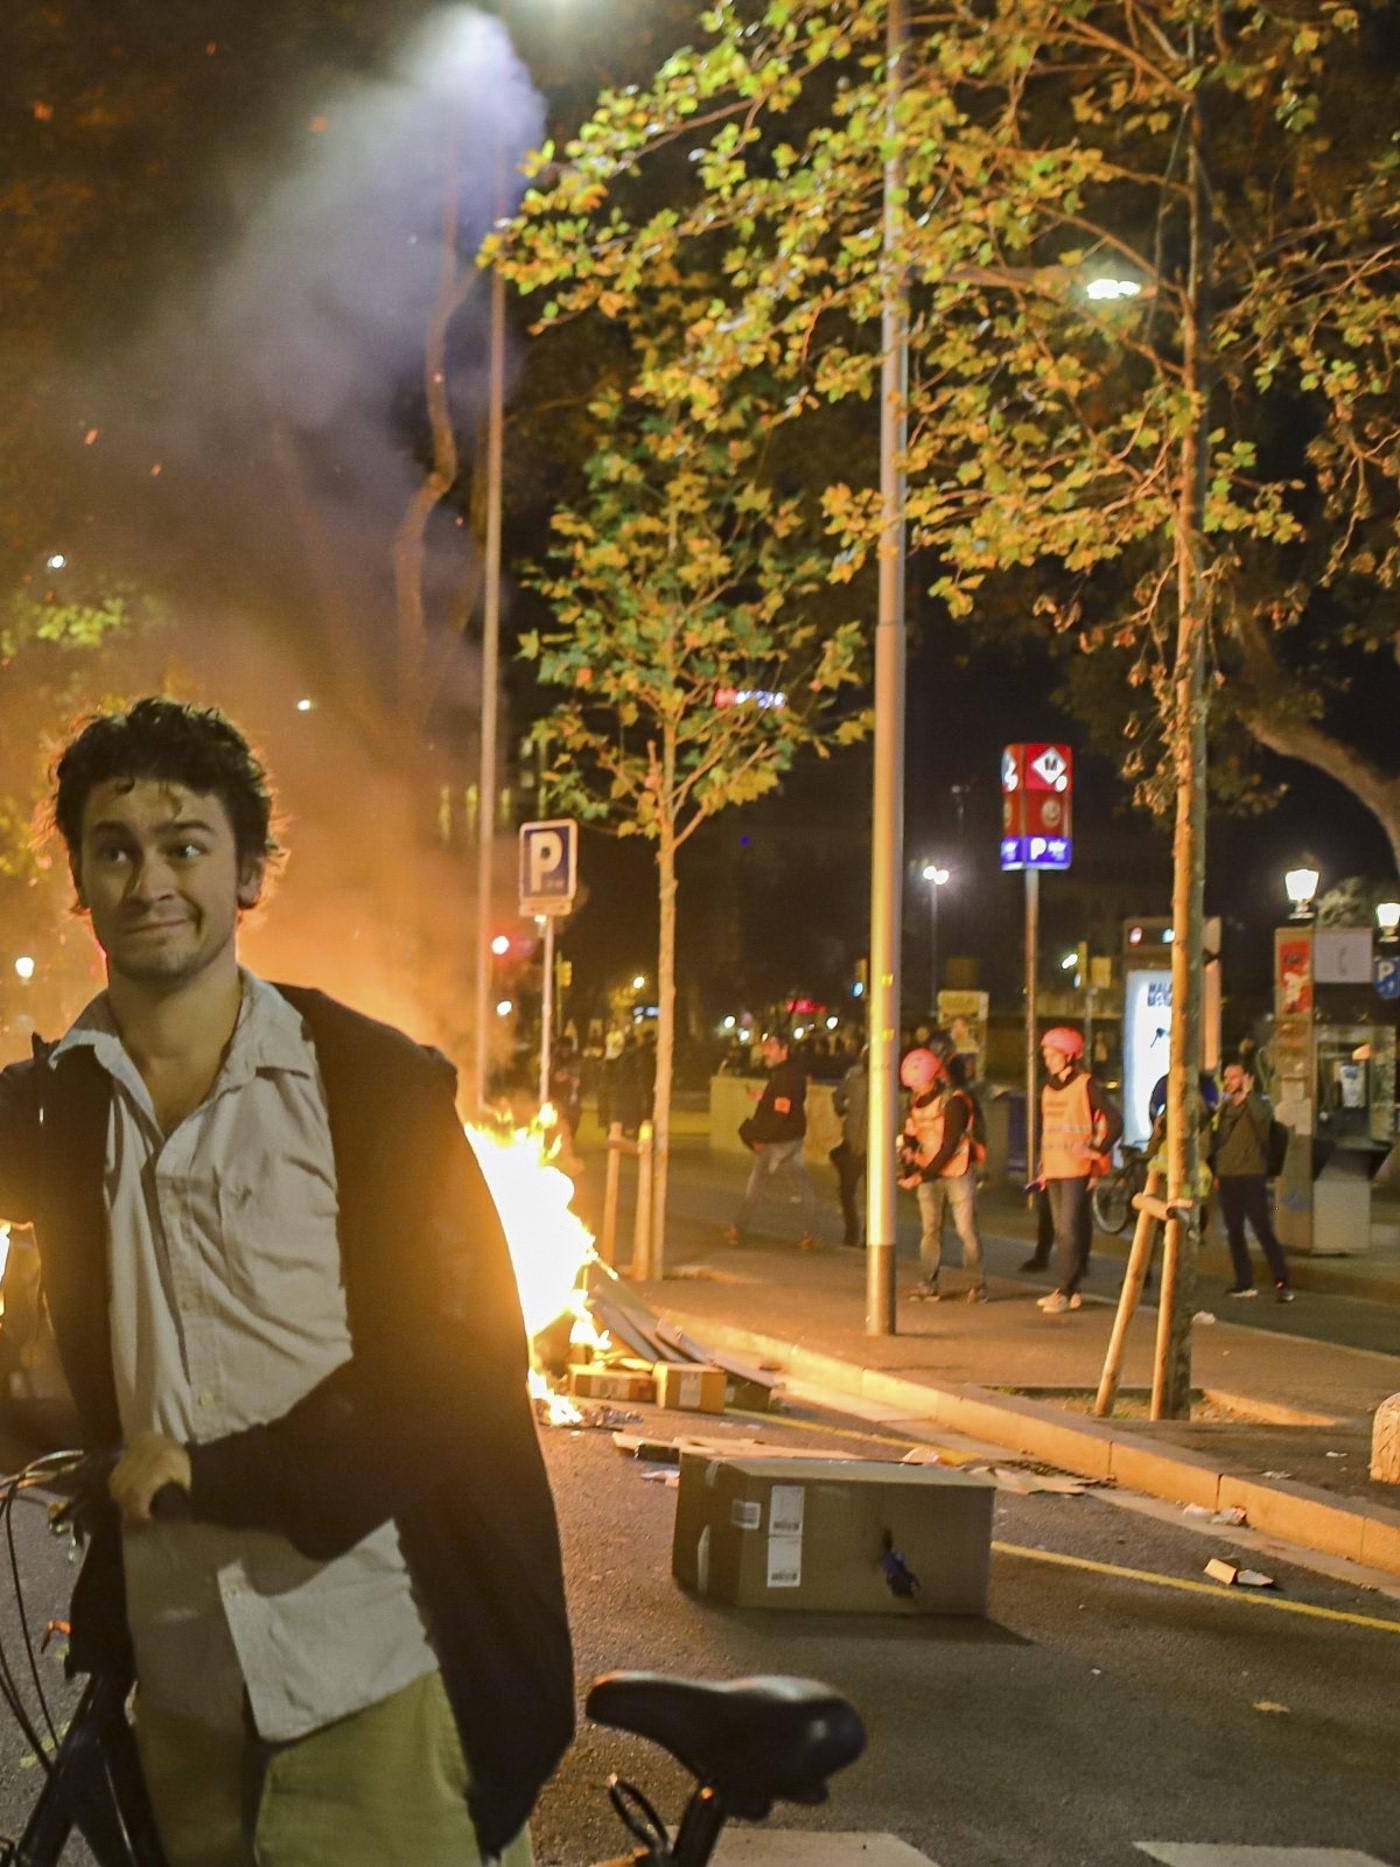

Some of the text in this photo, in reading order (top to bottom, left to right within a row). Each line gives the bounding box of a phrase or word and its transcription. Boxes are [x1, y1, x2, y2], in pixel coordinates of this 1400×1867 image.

[1031, 837, 1046, 859] P
[530, 831, 562, 892] P
[1377, 961, 1394, 981] P
